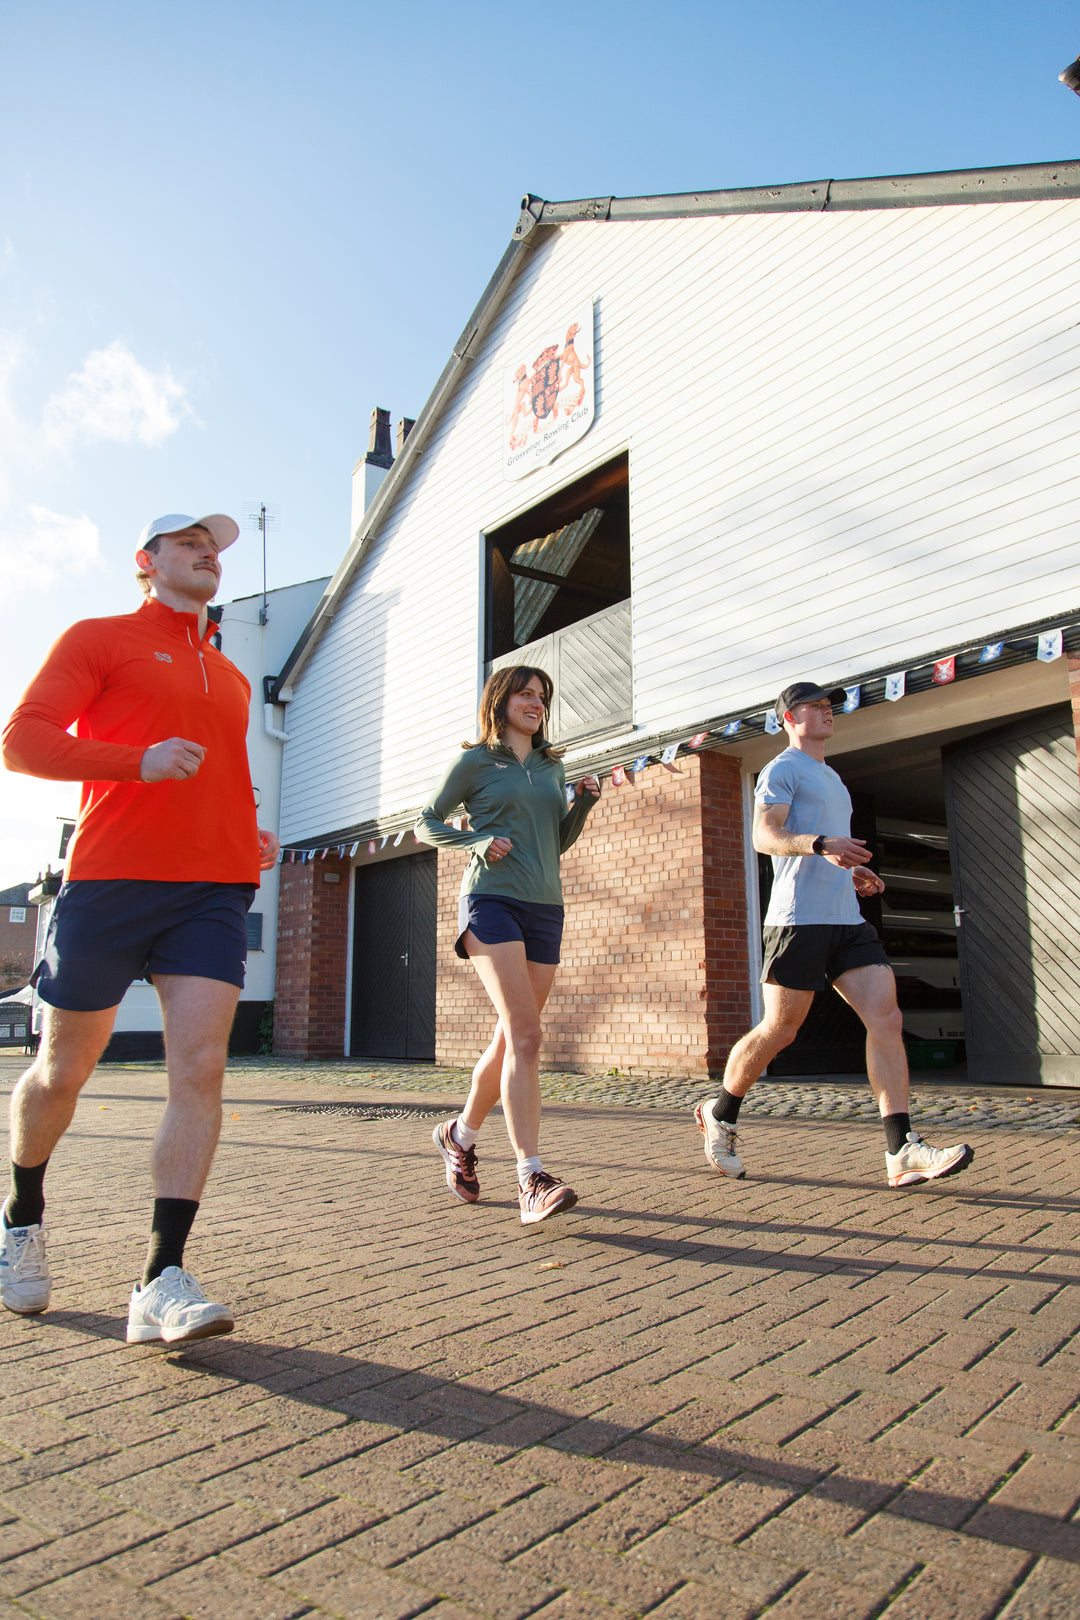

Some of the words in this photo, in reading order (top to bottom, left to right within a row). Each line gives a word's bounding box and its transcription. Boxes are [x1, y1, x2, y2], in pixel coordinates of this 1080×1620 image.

[507, 440, 541, 466] Grosvenor
[543, 421, 570, 442] Rowing
[571, 406, 589, 423] Club
